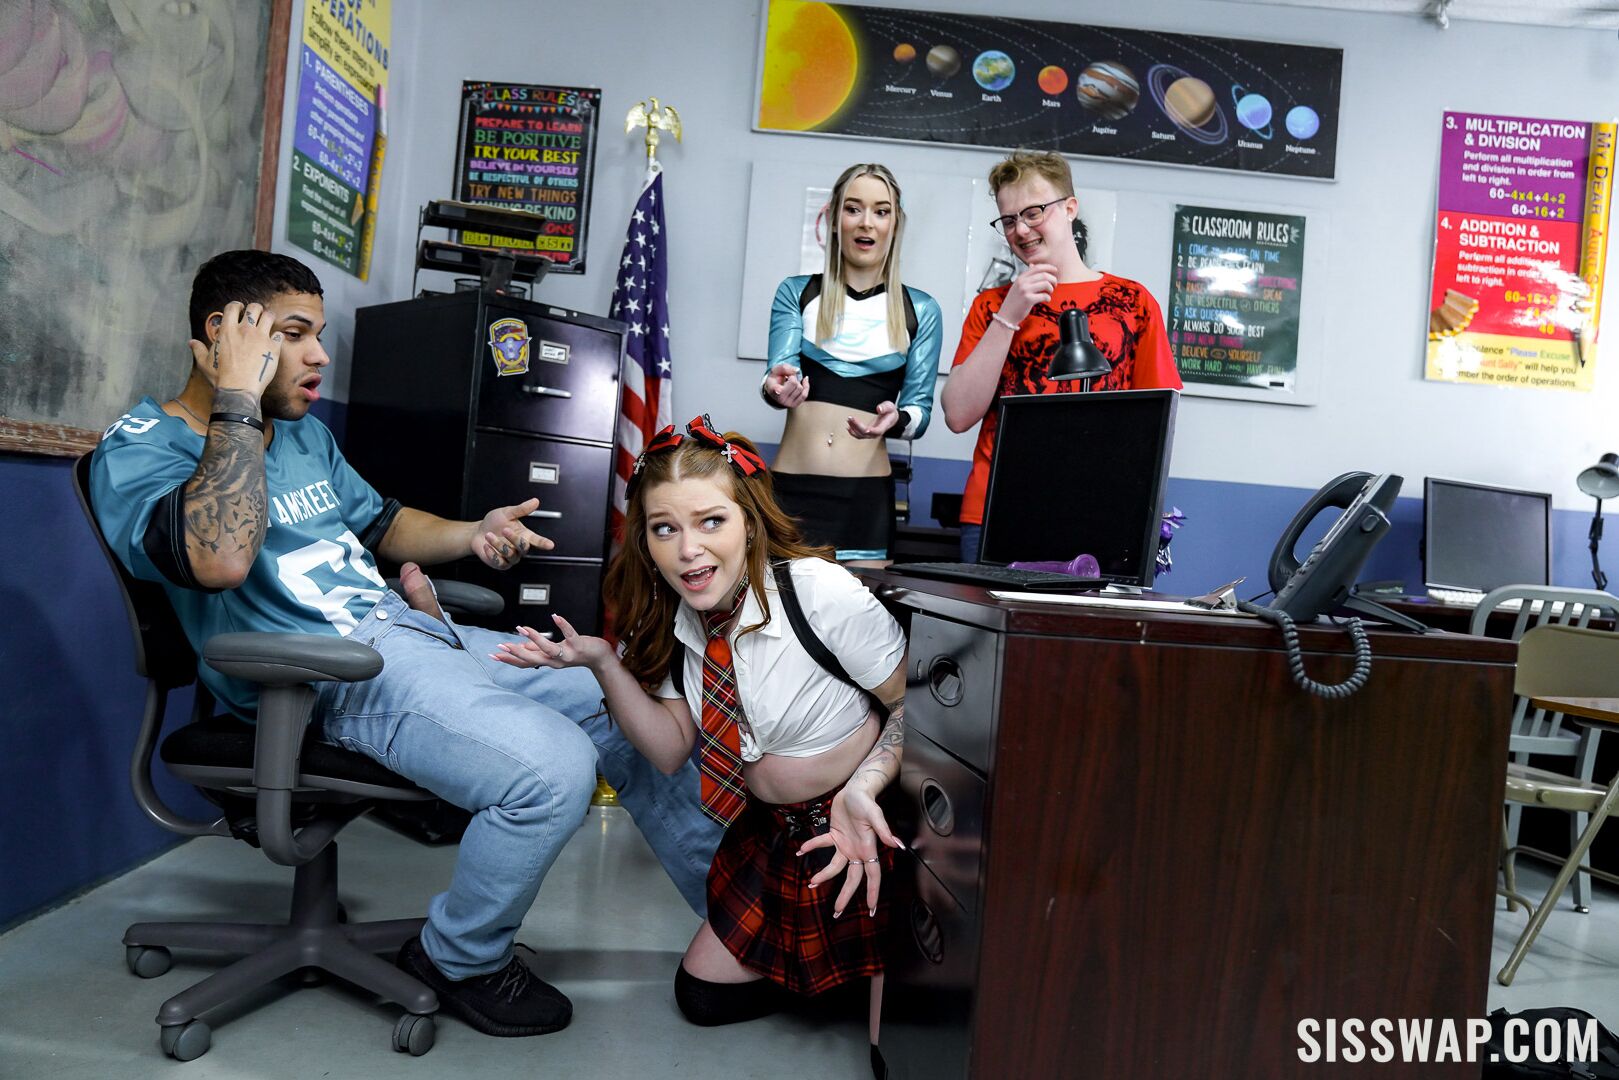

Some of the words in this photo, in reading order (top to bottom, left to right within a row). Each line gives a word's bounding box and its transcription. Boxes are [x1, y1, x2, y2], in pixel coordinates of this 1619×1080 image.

[304, 52, 313, 68] 1.
[315, 59, 369, 117] PARENTHESES
[885, 84, 916, 95] Mercury
[930, 88, 953, 98] Venus
[485, 88, 528, 102] CLASS
[532, 89, 577, 107] RULES
[981, 93, 1002, 103] Earth
[1041, 98, 1061, 108] Mars
[475, 116, 524, 130] PREPARE
[528, 120, 543, 131] TO
[545, 121, 583, 134] LEARN
[1092, 125, 1117, 137] Jupiter
[1445, 116, 1458, 129] 3.
[1465, 117, 1586, 140] MULTIPLICATION
[474, 129, 497, 144] BE
[501, 131, 582, 150] POSITIVE
[1151, 130, 1176, 141] Saturn
[1464, 133, 1475, 147] &
[1478, 134, 1542, 152] DIVISION
[1237, 139, 1264, 150] Uranus
[1285, 144, 1316, 155] Neptune
[1594, 131, 1611, 159] MY
[473, 145, 501, 160] TRY
[503, 147, 540, 163] YOUR
[542, 150, 580, 166] BEST
[1463, 150, 1500, 164] Perform
[1500, 155, 1512, 164] all
[1512, 155, 1573, 169] multiplication
[469, 159, 511, 172] BELIEVE
[512, 162, 524, 172] IN
[525, 164, 579, 177] YOURSELF
[1462, 163, 1480, 173] and
[1480, 163, 1516, 176] division
[1516, 167, 1526, 176] in
[1527, 168, 1552, 178] order
[1553, 169, 1575, 180] from
[303, 162, 350, 203] EXPONENTS
[468, 171, 479, 182] BE
[482, 172, 531, 185] RESPECTFUL
[533, 176, 544, 185] OF
[547, 177, 579, 188] OTHERS
[1462, 172, 1477, 184] left
[1477, 174, 1487, 184] to
[1488, 175, 1513, 187] right.
[469, 183, 492, 199] TRY
[497, 185, 524, 200] NEW
[530, 188, 577, 204] THINGS
[1590, 164, 1609, 216] DEAR
[543, 206, 577, 222] KIND
[1191, 215, 1252, 240] CLASSROOM
[1256, 221, 1290, 244] RULES
[1440, 216, 1454, 231] 4.
[1459, 218, 1527, 237] ADDITION
[1529, 225, 1541, 239] &
[1459, 234, 1561, 255] SUBTRACTION
[1188, 243, 1209, 256] COME
[1249, 249, 1261, 262] ON
[1264, 250, 1280, 264] TIME
[1458, 250, 1493, 264] Perform
[1494, 253, 1505, 263] all
[1187, 255, 1197, 269] BE
[1457, 262, 1506, 275] subtraction
[1506, 265, 1517, 276] in
[1455, 272, 1471, 285] left
[1471, 275, 1481, 285] to
[1481, 276, 1505, 288] right.
[1184, 307, 1197, 319] ASK
[1253, 299, 1281, 315] OTHERS
[1173, 319, 1180, 331] 7.
[1183, 319, 1211, 333] ALWAYS
[1214, 322, 1224, 335] DO
[1247, 326, 1266, 339] BEST
[1182, 345, 1209, 360] BELIEVE
[1539, 347, 1571, 361] Excuse
[1181, 357, 1202, 371] WORK
[1204, 358, 1223, 373] HARD
[1524, 361, 1540, 372] will
[1540, 363, 1560, 375] help
[1560, 366, 1578, 376] you
[1480, 370, 1495, 381] the
[1496, 372, 1518, 384] order
[1519, 374, 1531, 385] of
